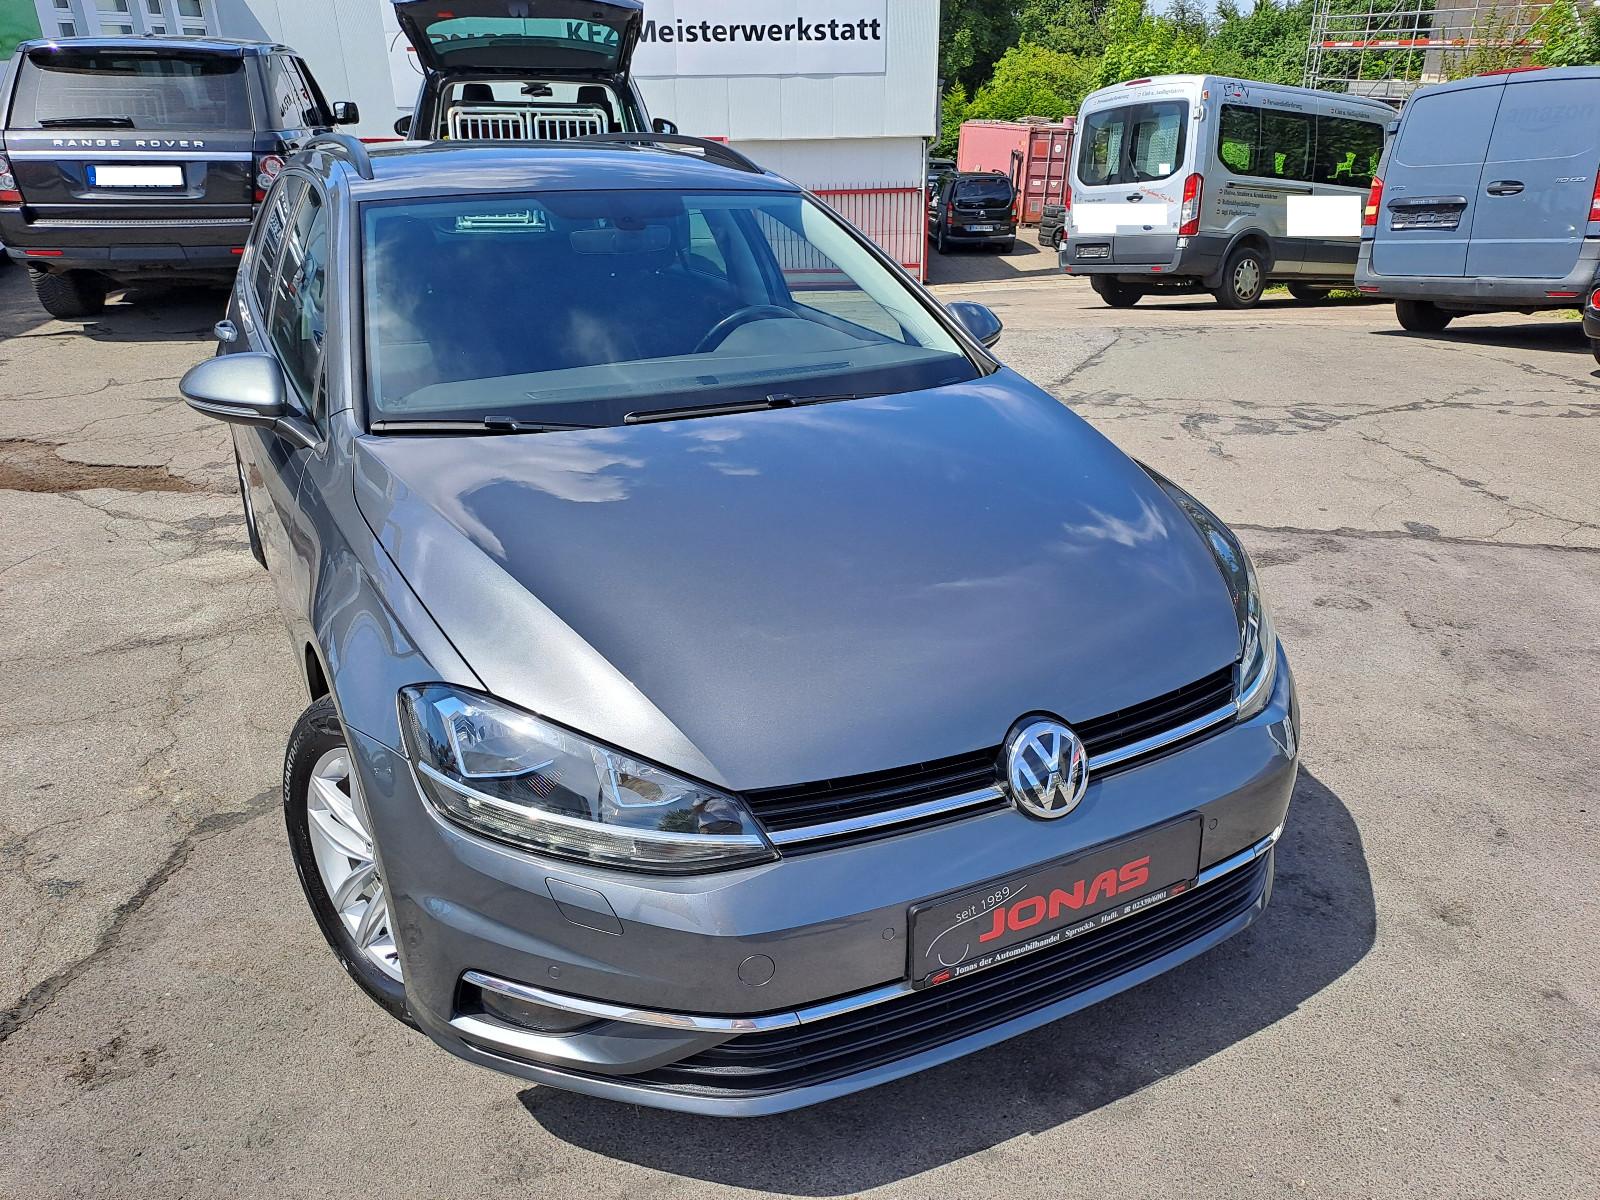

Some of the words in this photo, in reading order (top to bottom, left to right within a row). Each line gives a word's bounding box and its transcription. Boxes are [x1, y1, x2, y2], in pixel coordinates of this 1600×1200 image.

[640, 17, 881, 43] Meisterwerkstatt
[53, 139, 121, 147] RANGE
[135, 140, 205, 148] ROVER
[955, 905, 976, 923] seit
[981, 886, 1010, 910] 1989
[979, 855, 1151, 943] JONAS
[954, 963, 978, 977] Jonas
[979, 956, 993, 969] der
[994, 933, 1060, 961] Automobilhandel
